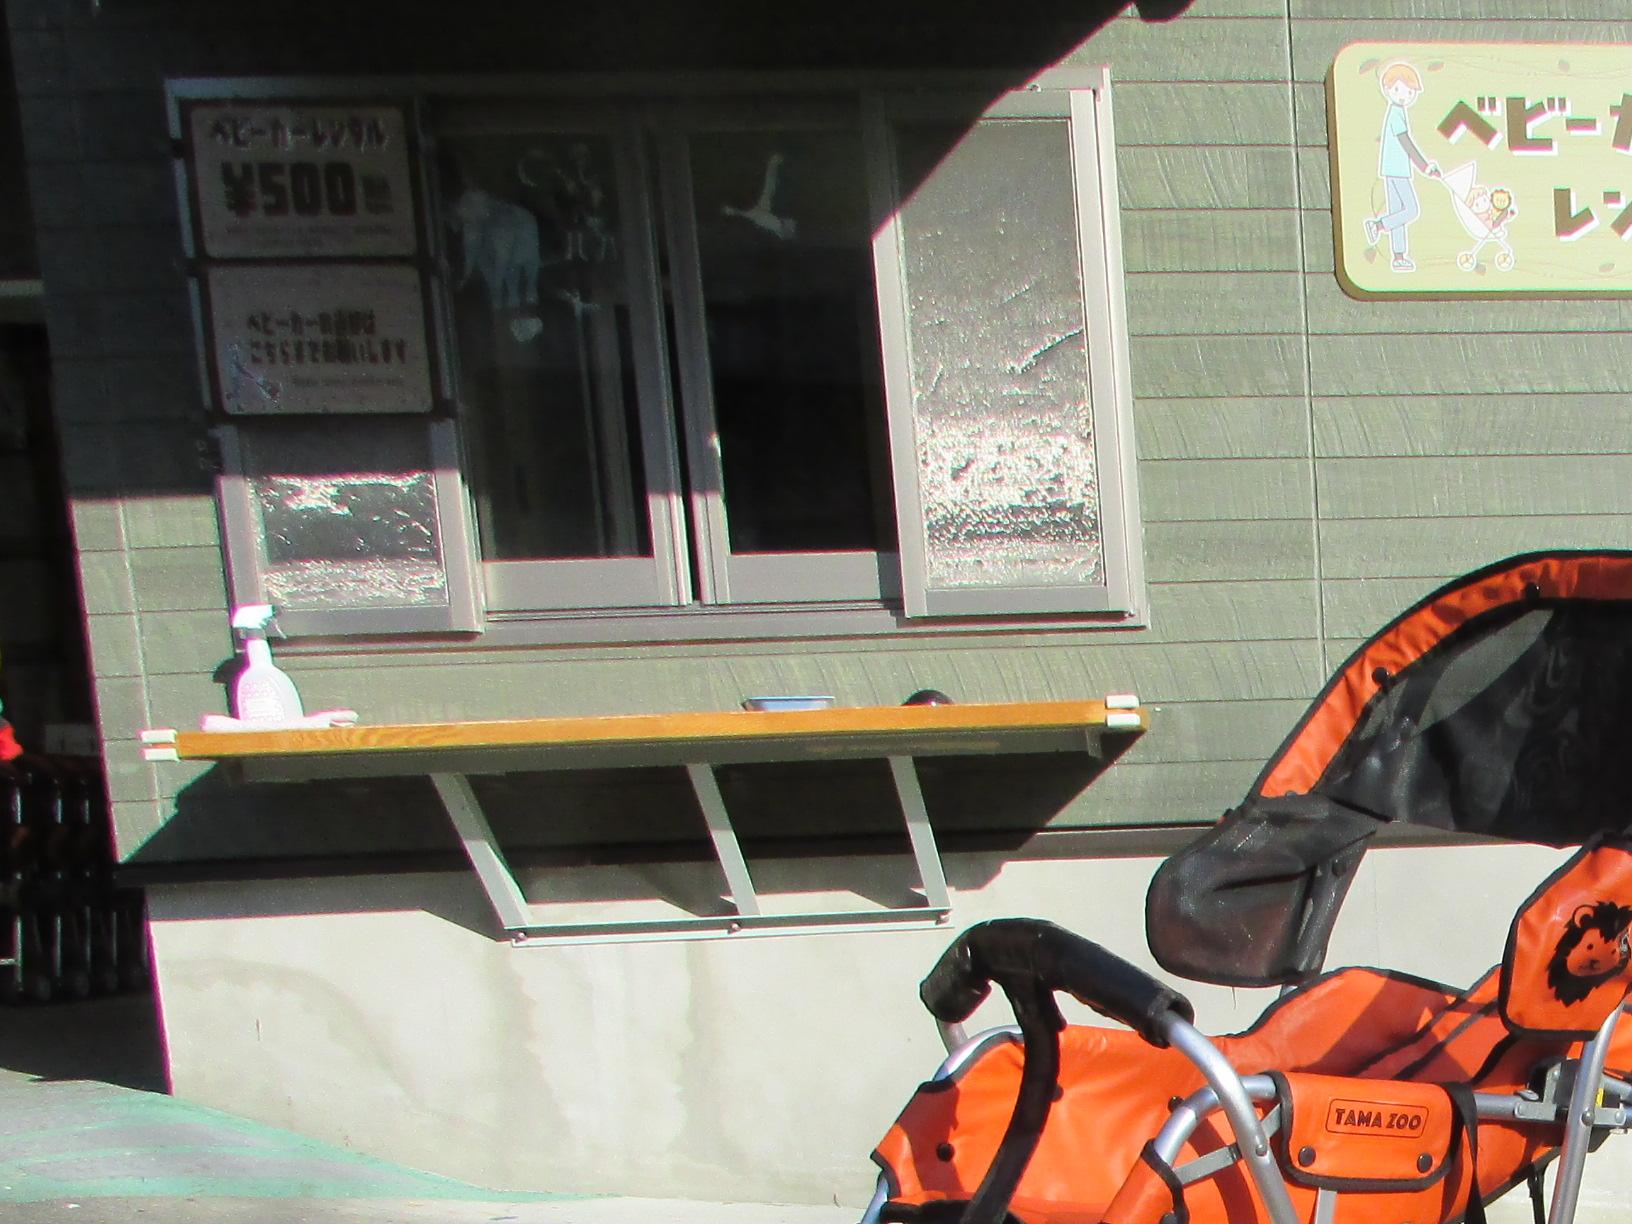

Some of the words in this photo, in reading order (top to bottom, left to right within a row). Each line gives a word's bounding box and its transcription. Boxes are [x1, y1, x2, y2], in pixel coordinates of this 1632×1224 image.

[221, 161, 358, 217] ¥500
[1335, 1107, 1383, 1128] TAMA
[1385, 1112, 1422, 1131] ZOO
